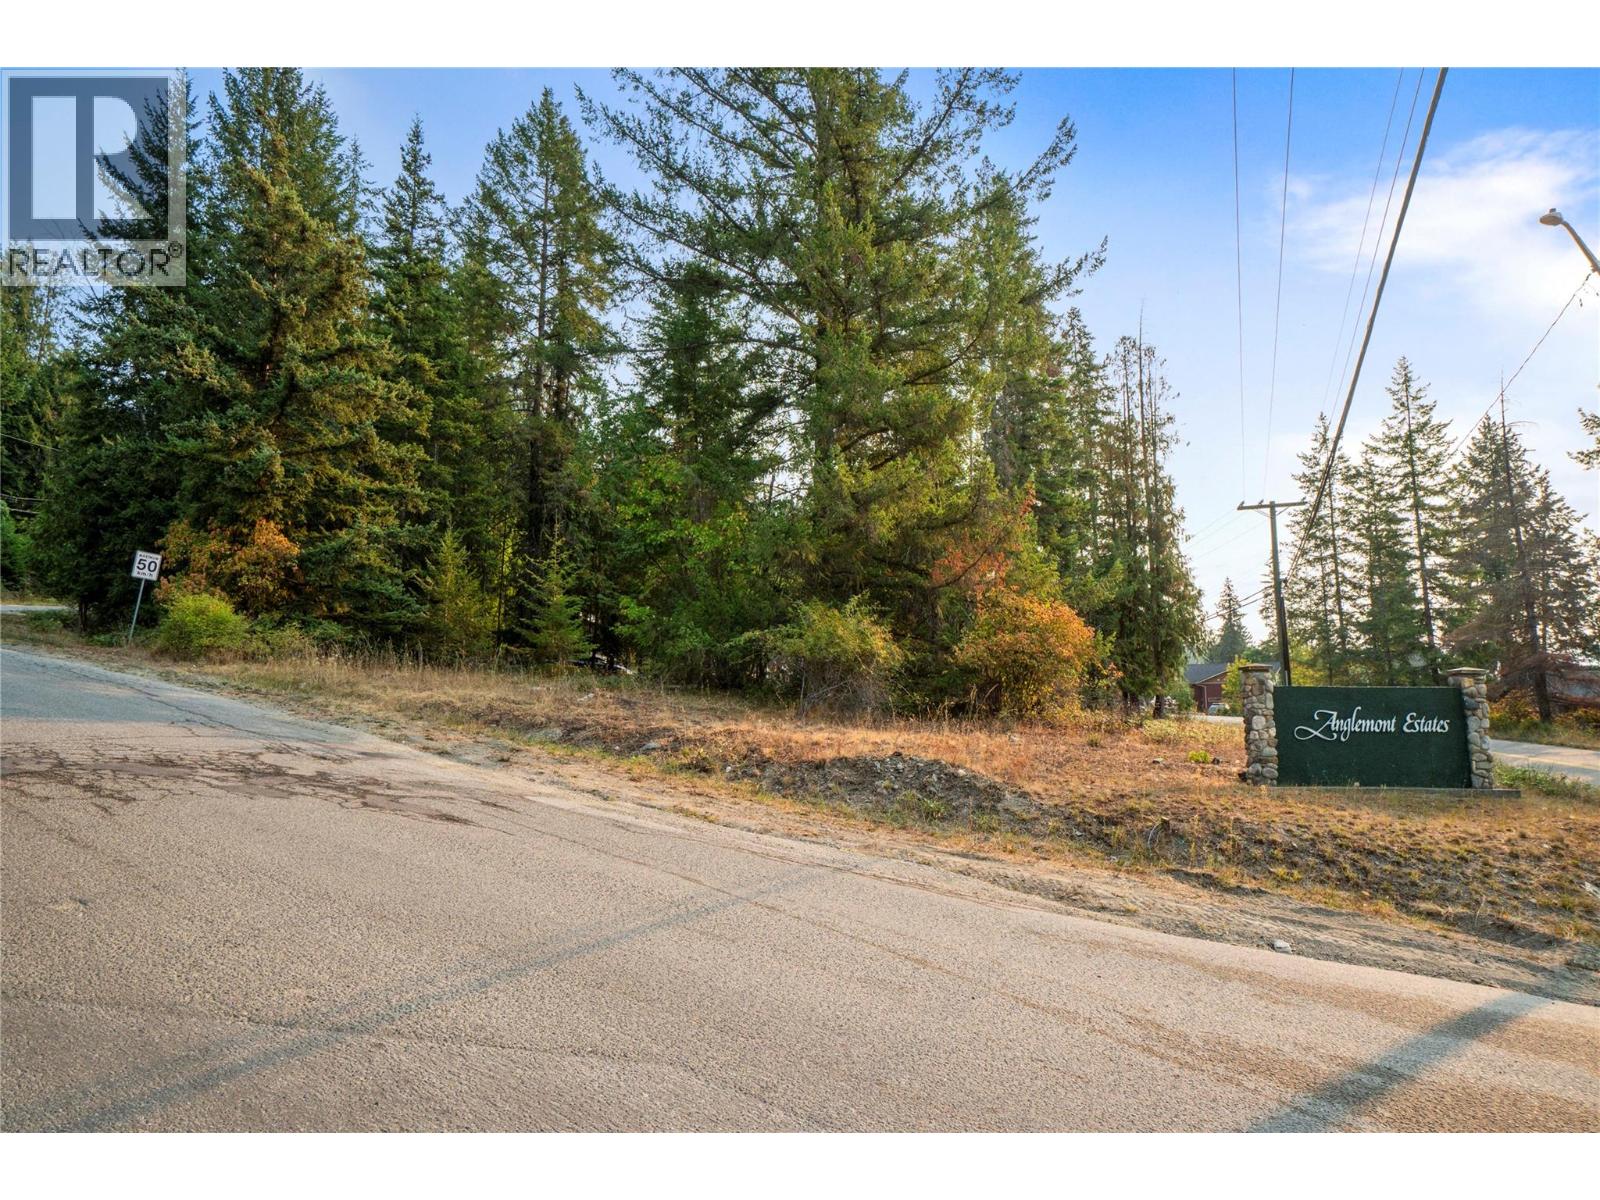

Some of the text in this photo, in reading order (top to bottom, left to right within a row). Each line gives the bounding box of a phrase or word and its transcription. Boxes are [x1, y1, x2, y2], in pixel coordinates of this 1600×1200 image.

[136, 559, 157, 572] 50
[1294, 706, 1450, 742] Anglemont Estates
